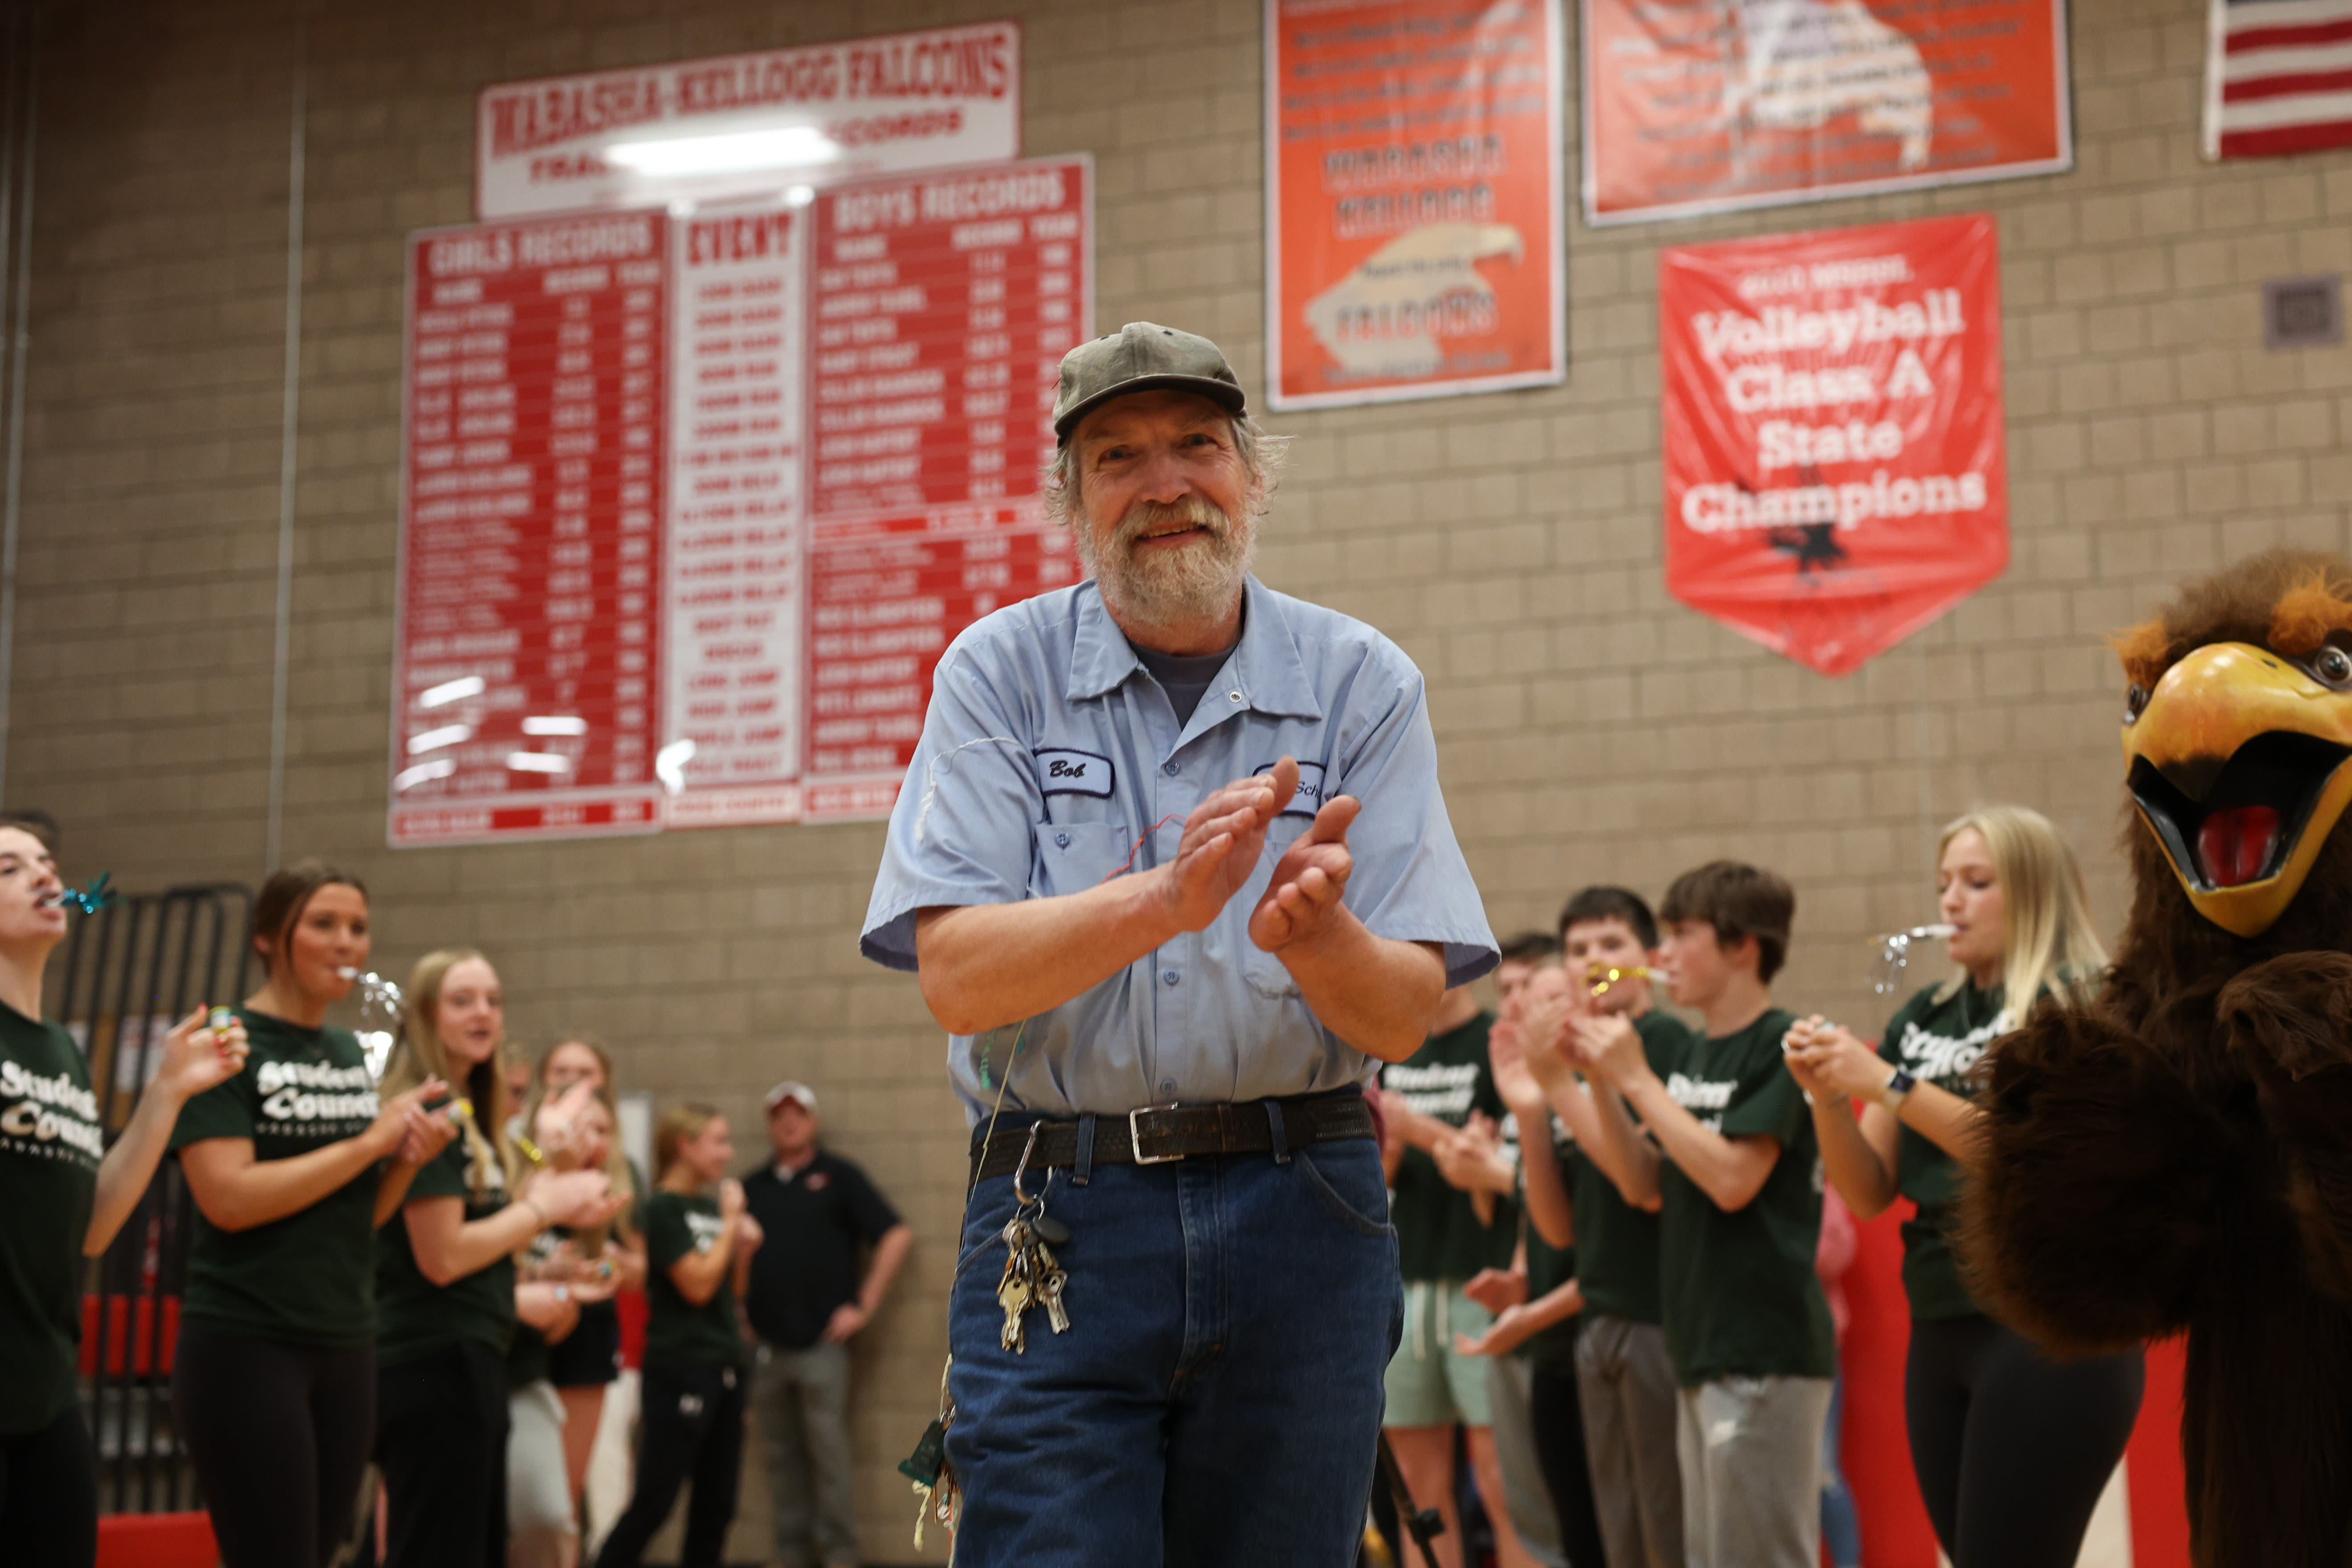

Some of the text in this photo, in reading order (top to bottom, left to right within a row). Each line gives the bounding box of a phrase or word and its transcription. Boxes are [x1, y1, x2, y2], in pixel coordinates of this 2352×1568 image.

[847, 35, 1007, 98] FALCONS
[1691, 289, 1965, 358] Volleyball
[1725, 349, 1935, 412] Class A
[1755, 419, 1903, 469] State
[1679, 470, 1988, 533] Champions
[1049, 760, 1087, 778] Bob
